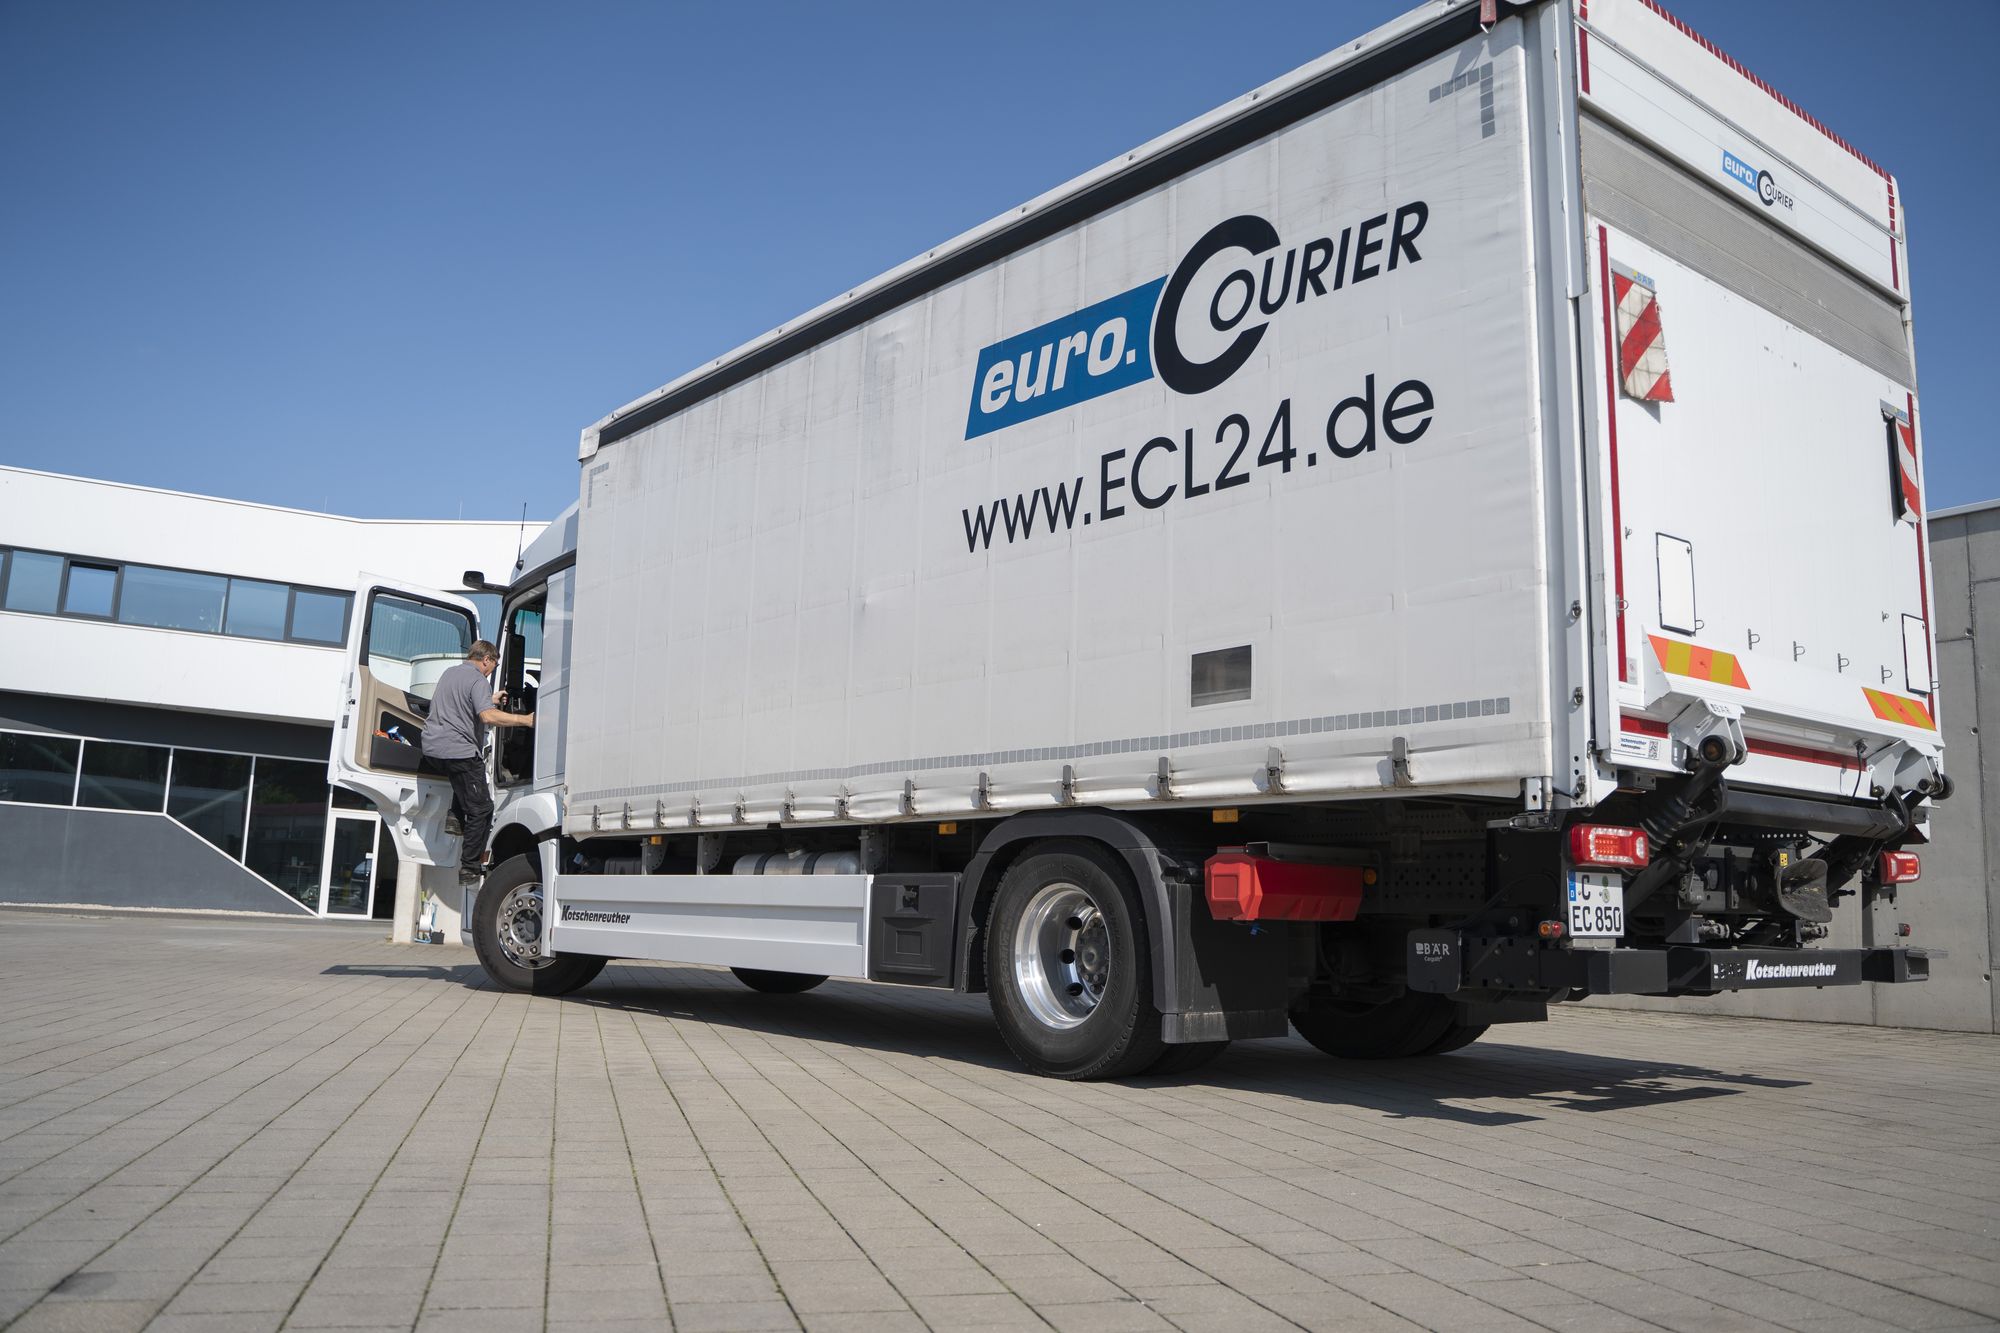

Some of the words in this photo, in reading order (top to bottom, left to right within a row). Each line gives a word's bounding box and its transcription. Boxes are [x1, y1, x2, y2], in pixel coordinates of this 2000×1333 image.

[1724, 156, 1755, 186] euro.
[1757, 170, 1794, 211] COURIER
[979, 316, 1136, 415] euro.
[1153, 200, 1429, 395] COURIER
[962, 373, 1435, 554] www.ECL24.de
[1581, 874, 1591, 901] C
[561, 904, 631, 924] Kotschenreuther
[1572, 905, 1592, 932] EC
[1595, 906, 1622, 932] 850
[1745, 959, 1837, 981] Kotschenreuther
